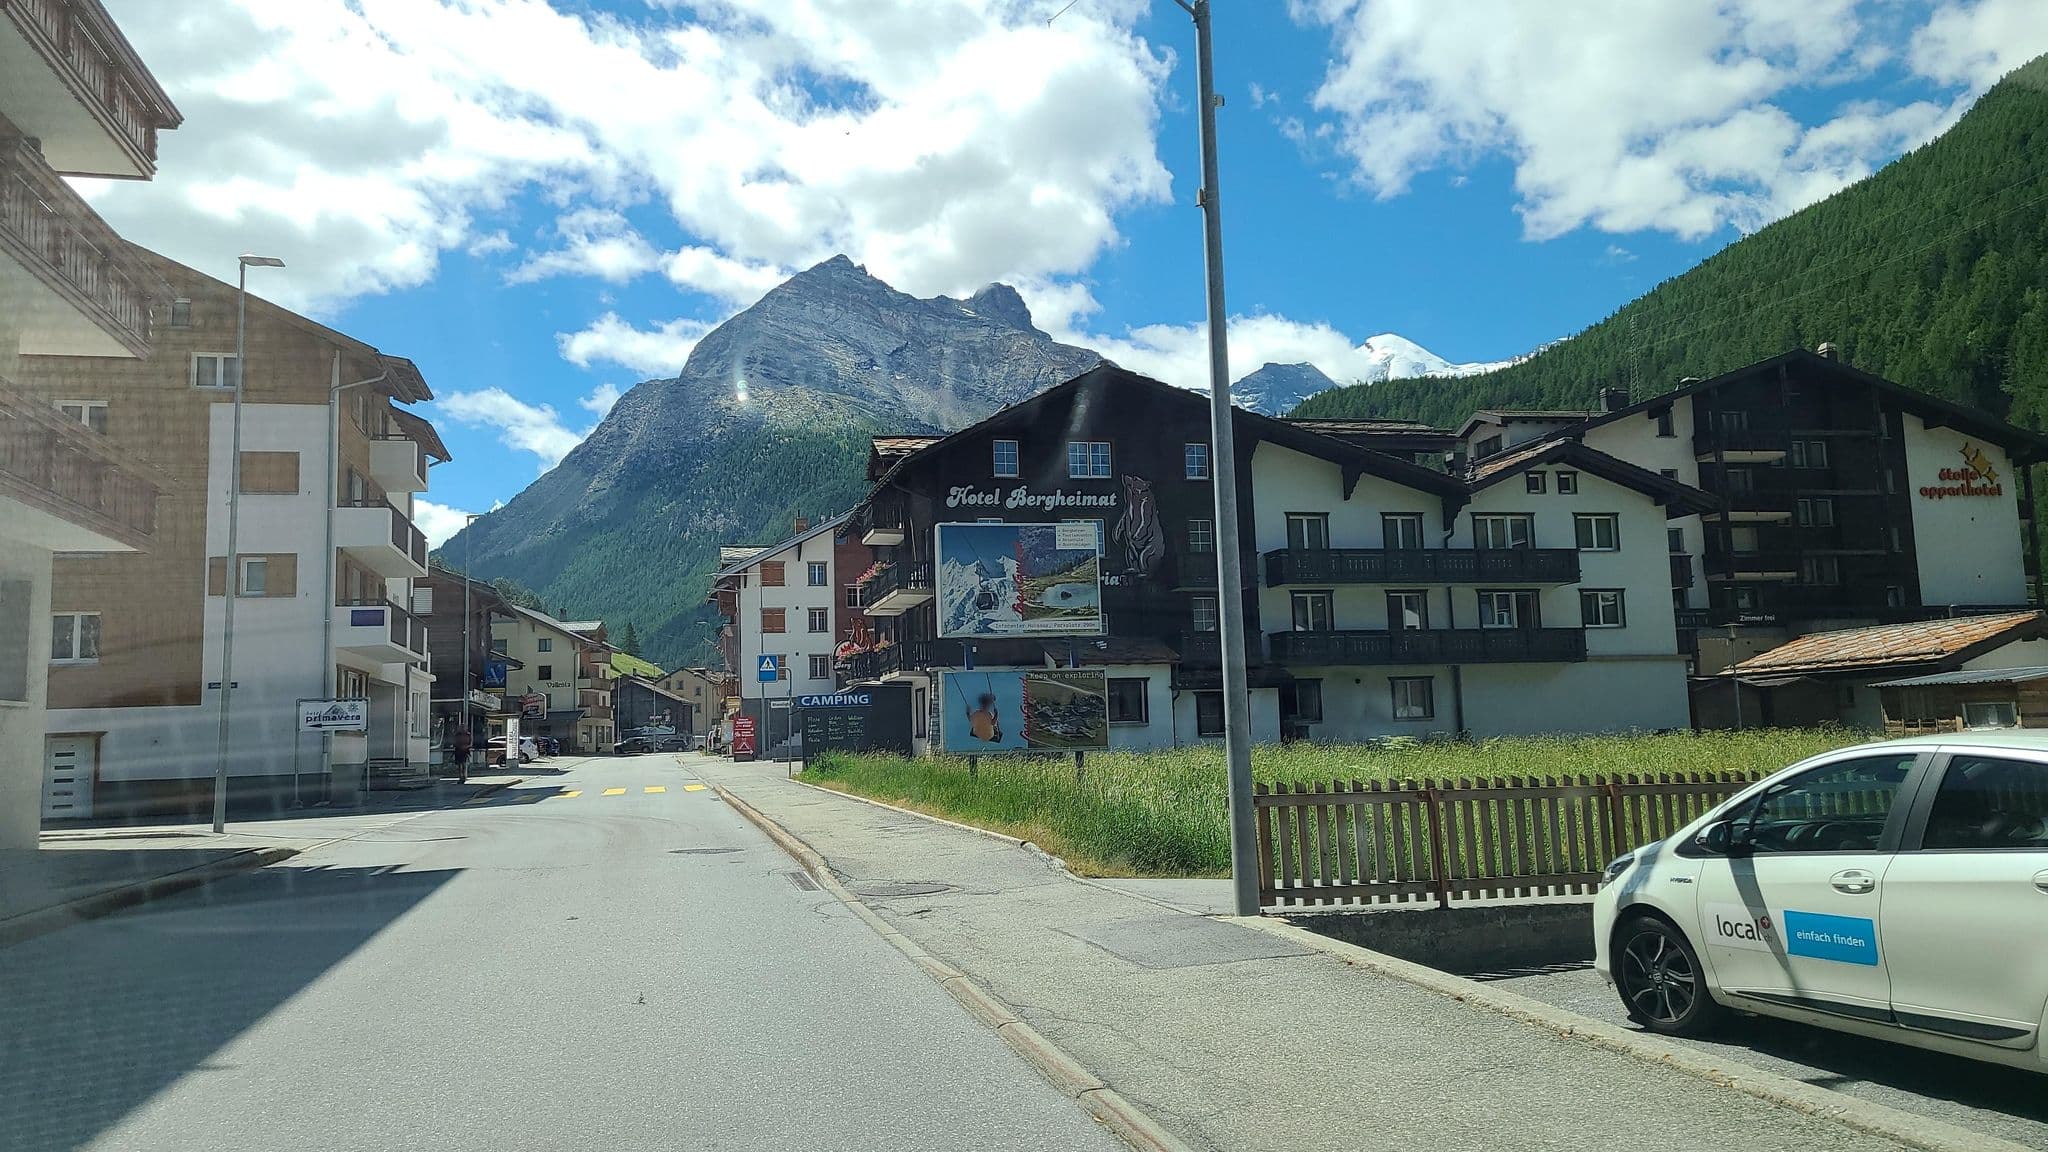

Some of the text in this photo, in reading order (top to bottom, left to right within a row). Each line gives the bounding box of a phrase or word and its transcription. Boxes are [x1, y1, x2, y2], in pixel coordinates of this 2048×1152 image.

[946, 485, 1117, 511] Hotel Bergheimat
[1919, 483, 2003, 499] apparthotel
[1030, 672, 1048, 681] Keep
[1065, 671, 1104, 681] exploring
[801, 694, 869, 706] CAMPING
[305, 714, 362, 723] primavera
[1716, 914, 1762, 941] local
[1796, 930, 1865, 947] einfach finden
